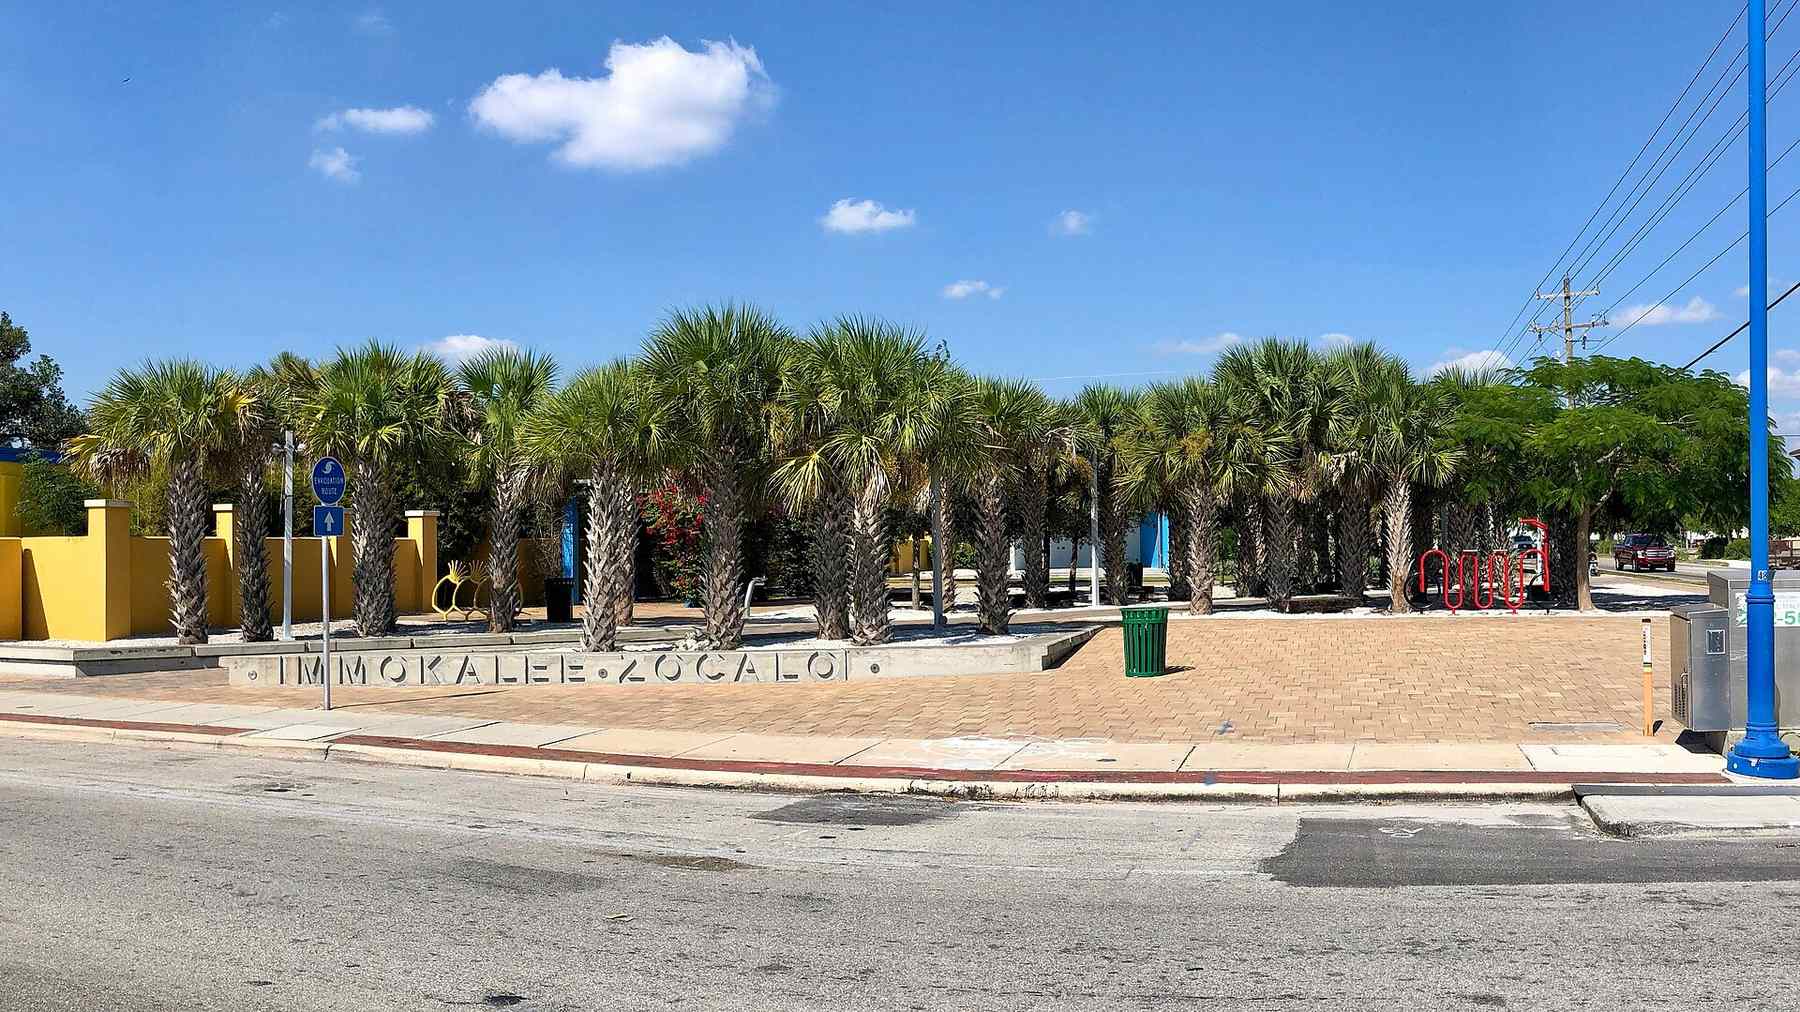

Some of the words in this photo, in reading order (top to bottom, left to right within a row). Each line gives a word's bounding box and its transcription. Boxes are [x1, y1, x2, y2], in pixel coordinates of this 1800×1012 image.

[321, 487, 337, 495] ROUTE
[279, 655, 588, 685] IMMOKALEE
[618, 652, 835, 682] ZOCALO
